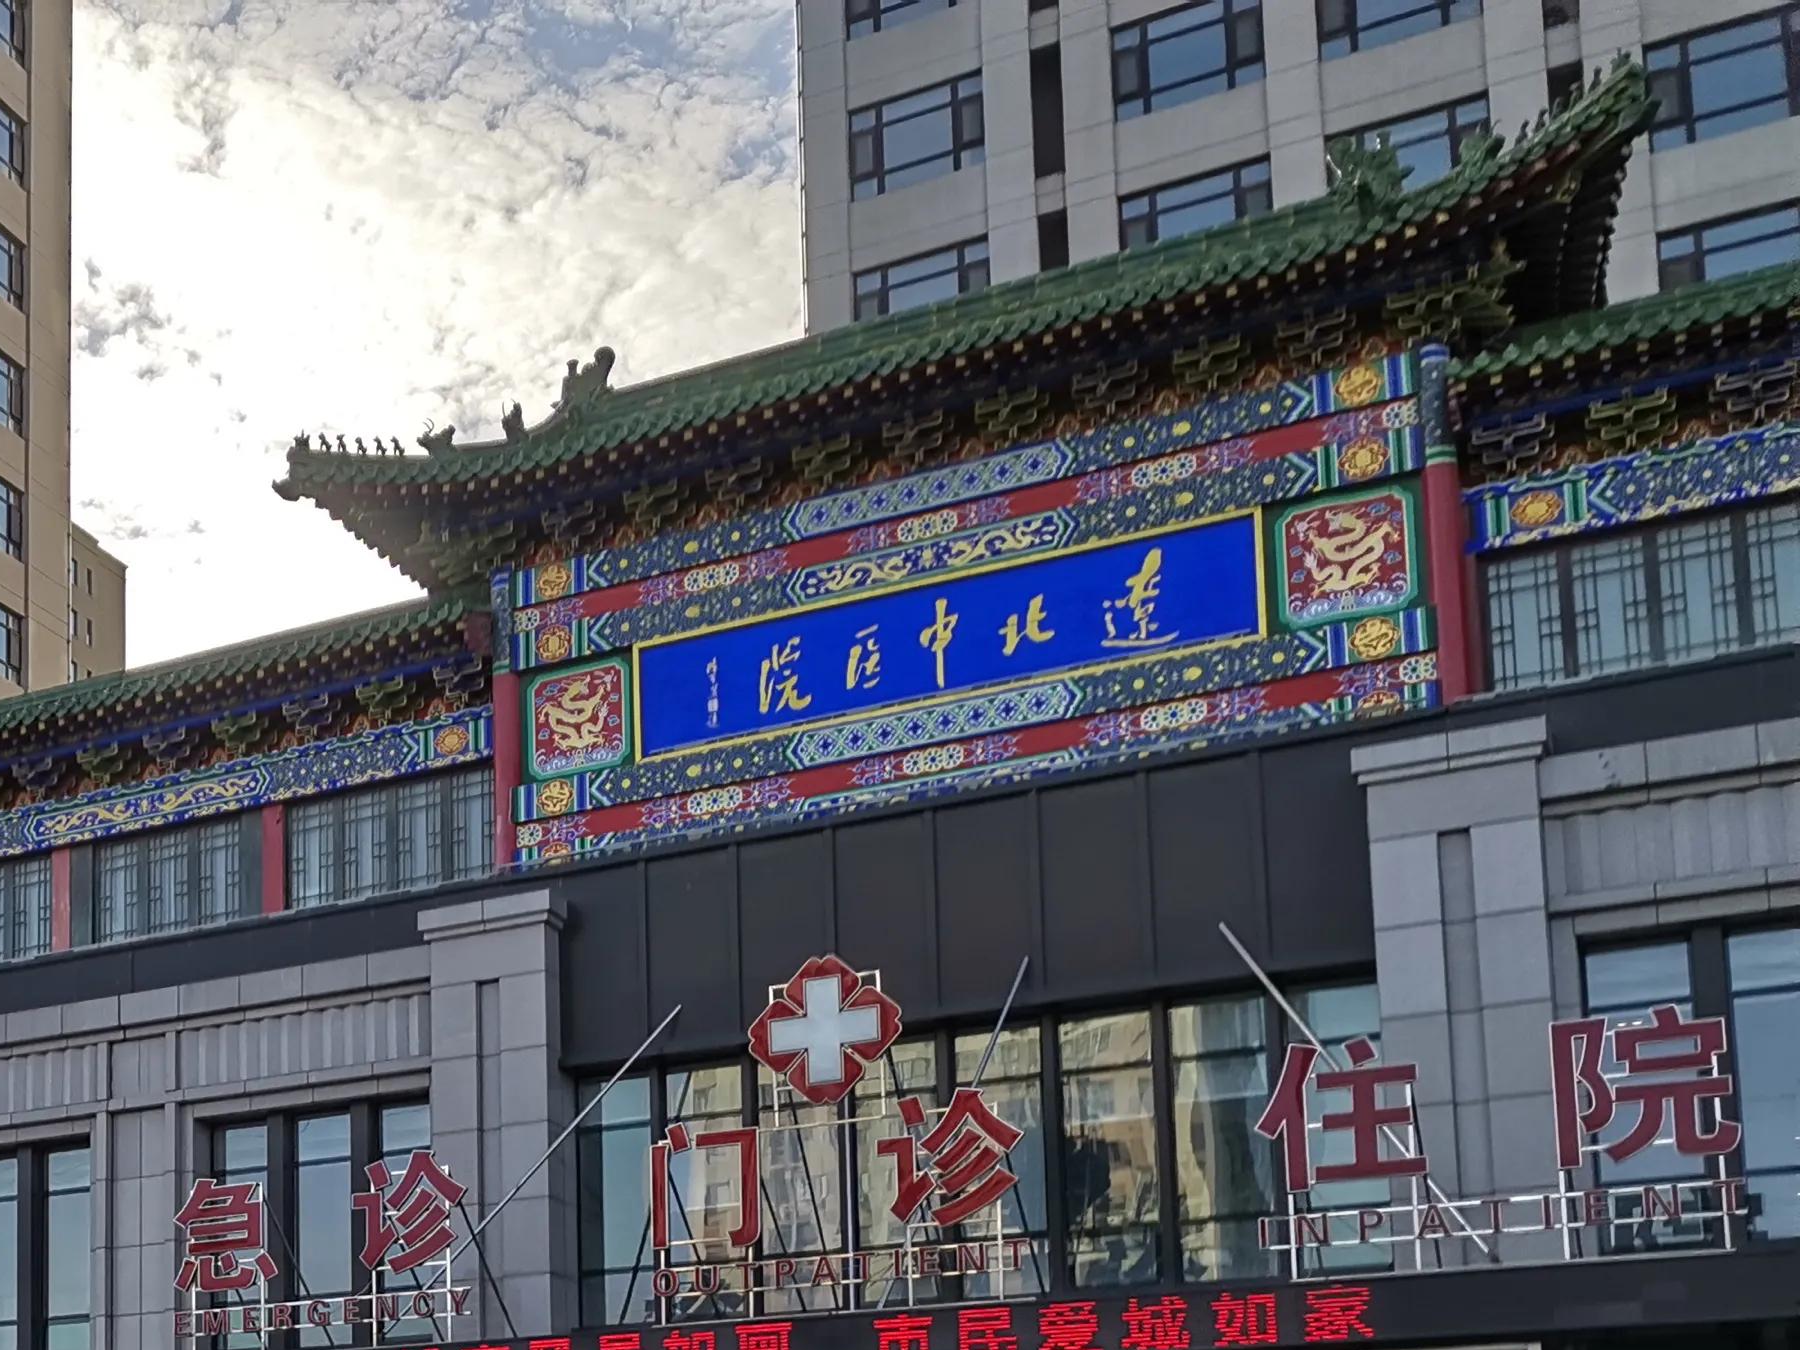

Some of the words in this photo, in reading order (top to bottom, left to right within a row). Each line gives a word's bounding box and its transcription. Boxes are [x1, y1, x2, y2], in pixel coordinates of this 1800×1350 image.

[1255, 1003, 1742, 1193] 住院
[173, 1150, 467, 1292] 急诊
[650, 1087, 1024, 1250] 门诊
[1257, 1179, 1745, 1249] INPATIENT
[174, 1289, 470, 1338] EMERGENCY
[653, 1238, 1030, 1297] OUTPATIENT
